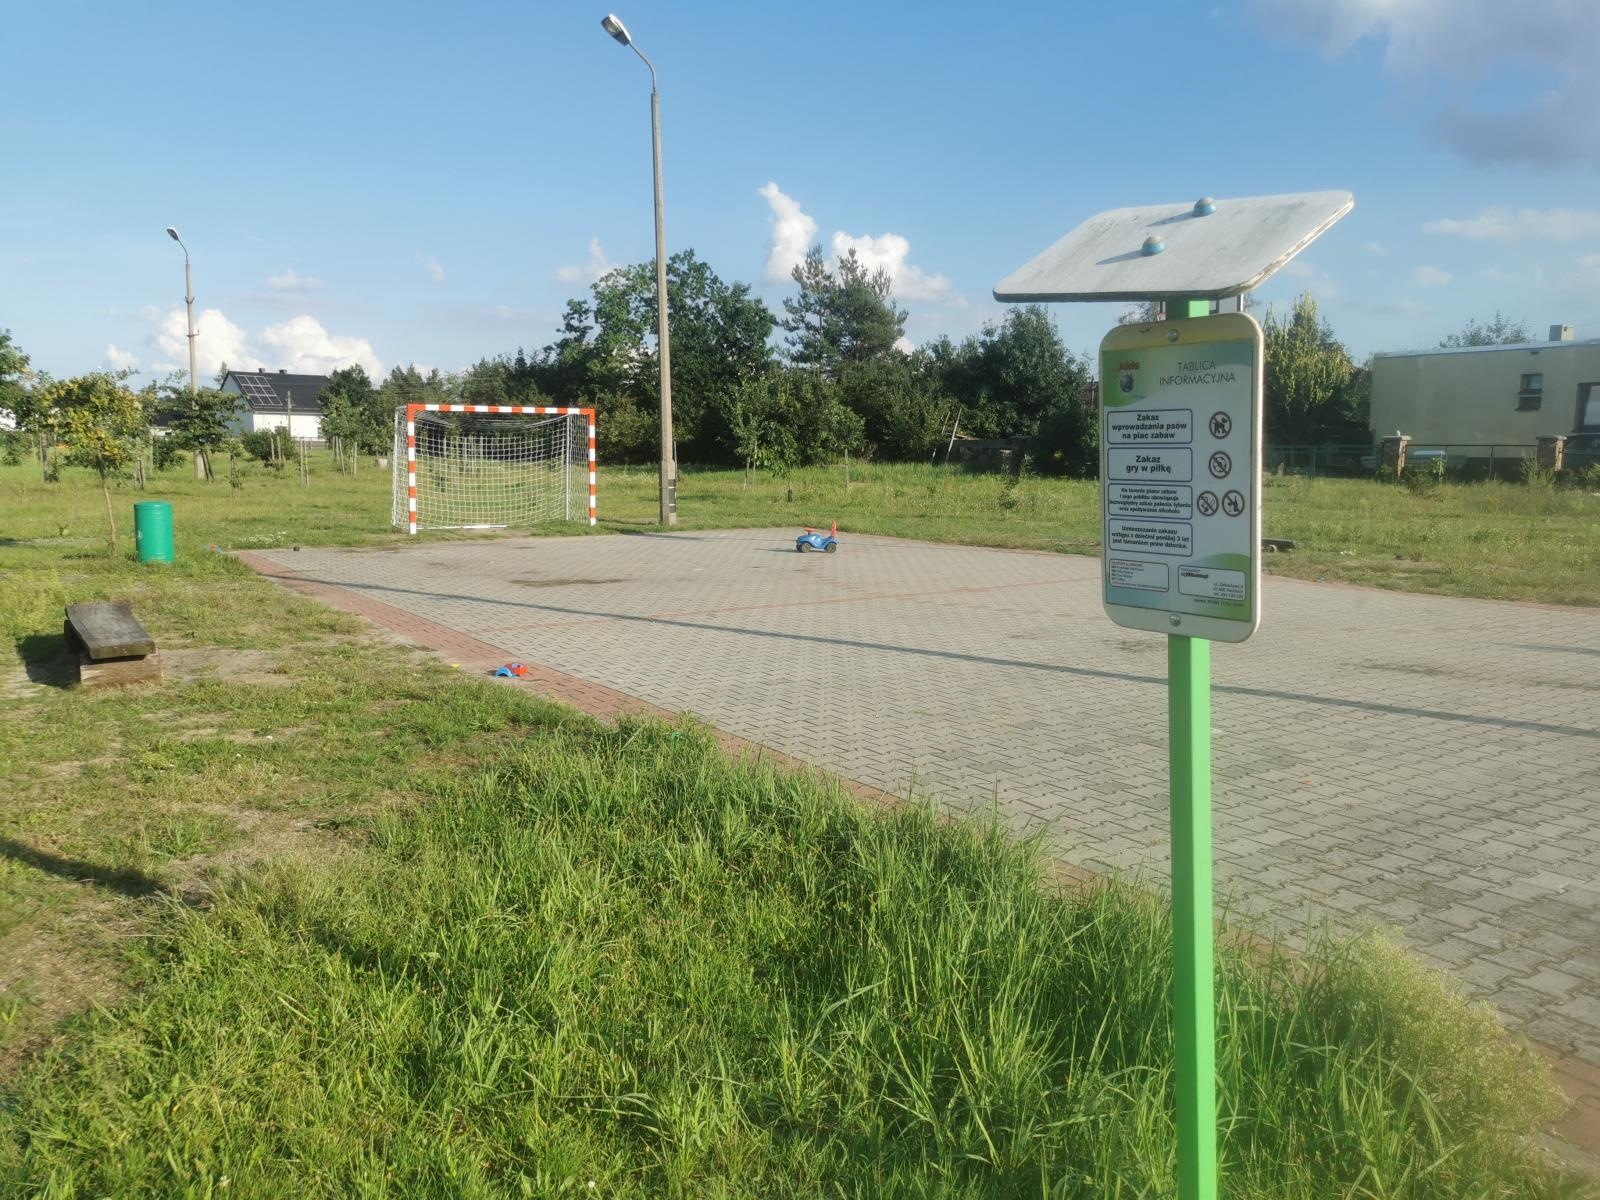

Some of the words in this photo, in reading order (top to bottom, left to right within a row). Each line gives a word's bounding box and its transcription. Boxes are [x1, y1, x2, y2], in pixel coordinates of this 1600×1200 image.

[1177, 360, 1216, 372] TABLICA
[1159, 373, 1236, 386] INFORMACYJNA
[1112, 423, 1164, 431] wprowadzania
[1166, 422, 1187, 430] psów
[1133, 432, 1149, 440] plac
[1150, 431, 1175, 439] zabaw
[1136, 455, 1161, 463] Zakaz
[1126, 465, 1139, 473] gry
